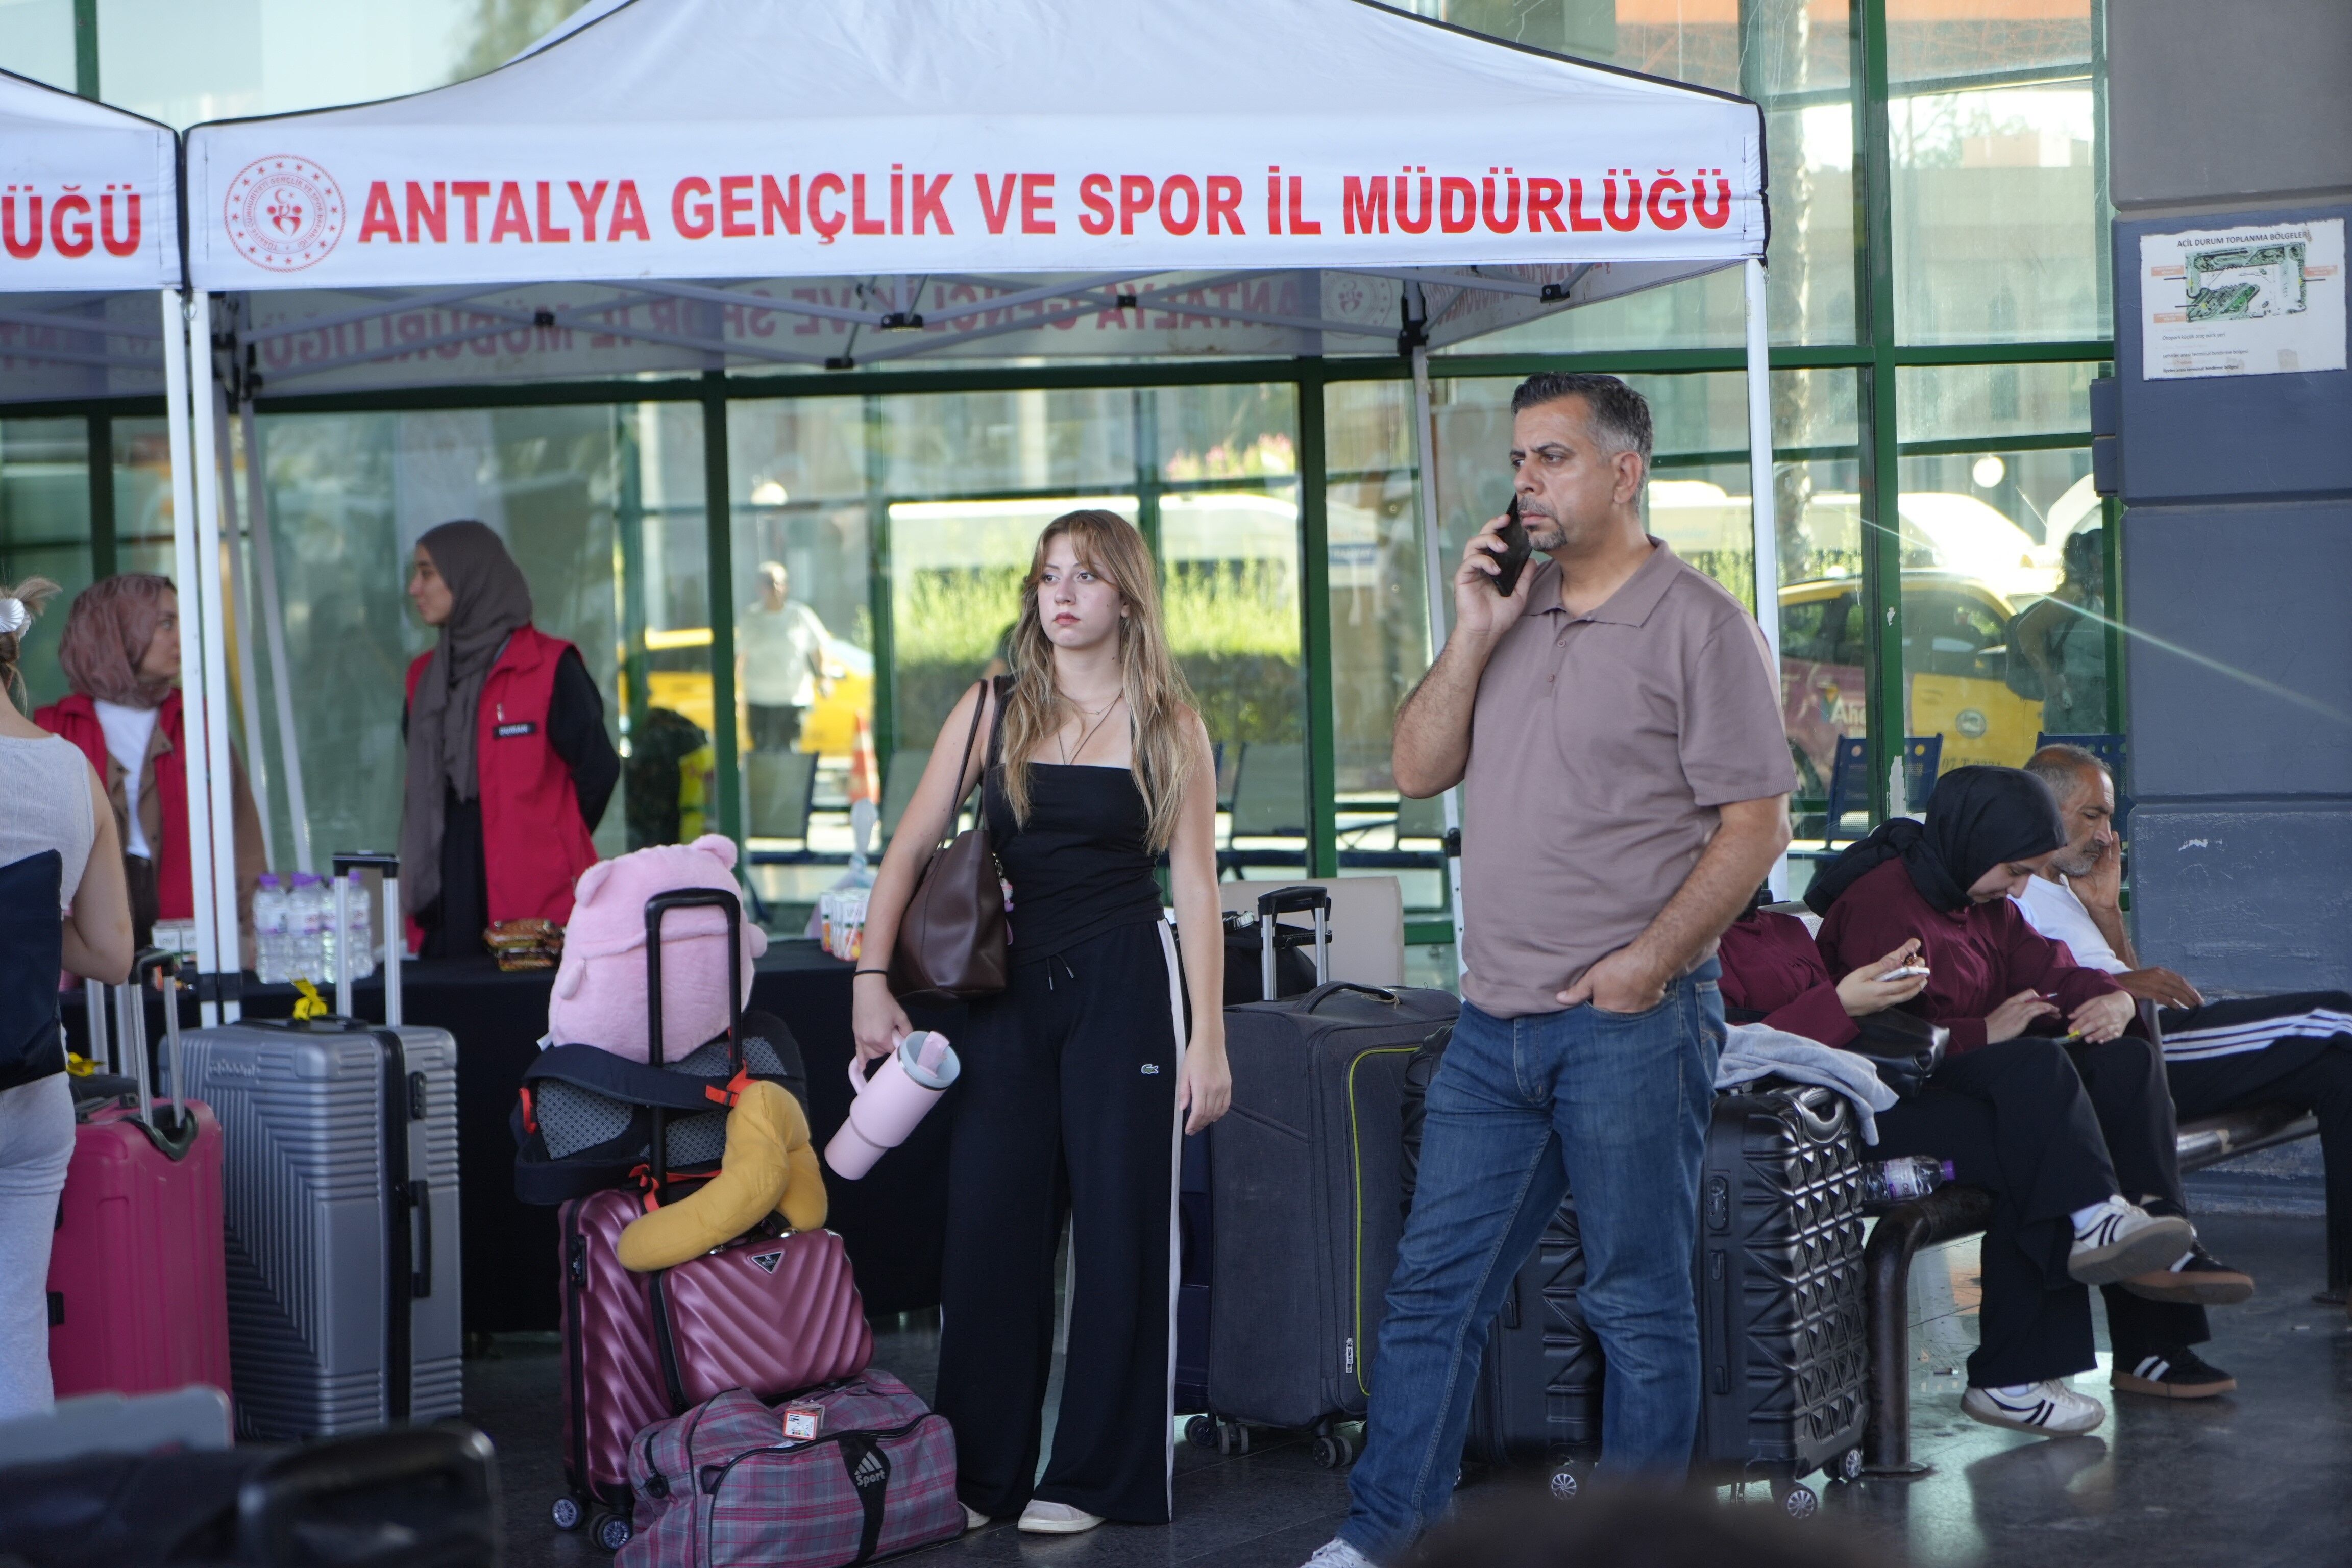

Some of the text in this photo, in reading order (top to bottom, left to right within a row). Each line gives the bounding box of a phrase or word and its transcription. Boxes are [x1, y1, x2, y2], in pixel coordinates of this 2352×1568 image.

[270, 177, 303, 186] GENÇLİK
[304, 183, 313, 192] VE
[311, 192, 323, 214] SPOR
[358, 163, 1731, 245] ANTALYA GENÇLİK VE SPOR İL MÜDÜRLÜĞÜ
[2177, 238, 2193, 248] ACİL
[2195, 237, 2224, 246] DURUM
[2226, 234, 2268, 244] TOPLANMA
[855, 1469, 886, 1488] Sport
